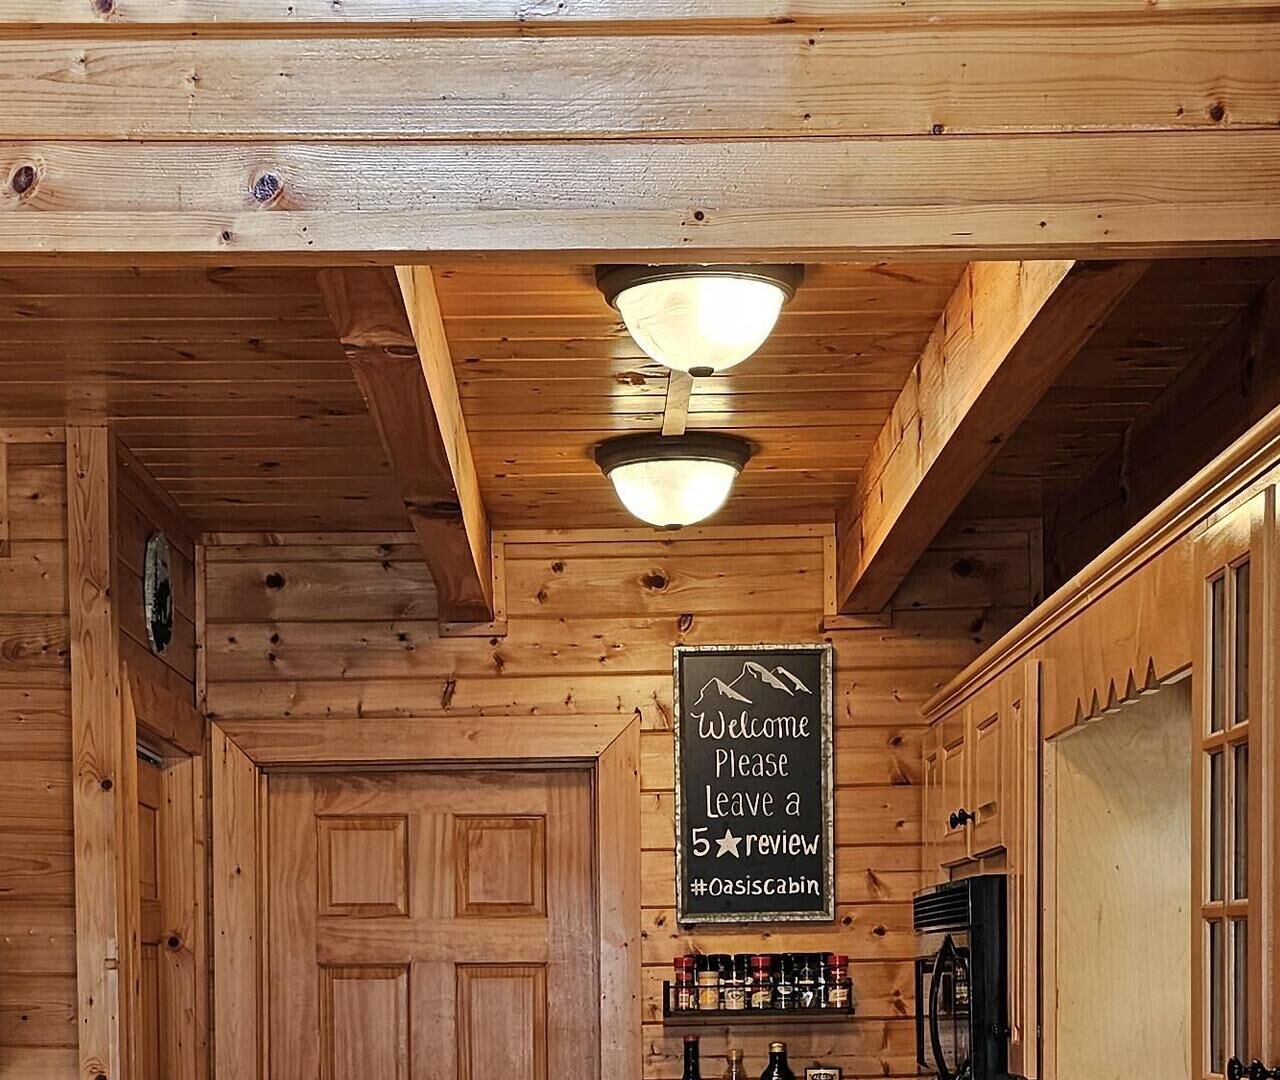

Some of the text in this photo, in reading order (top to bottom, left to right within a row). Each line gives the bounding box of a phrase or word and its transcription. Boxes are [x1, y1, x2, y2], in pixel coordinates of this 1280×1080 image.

[690, 711, 810, 739] Welcome
[715, 749, 788, 778] Please
[705, 785, 801, 818] Leave a
[746, 829, 820, 856] review
[690, 875, 820, 897] #Oasiscabin
